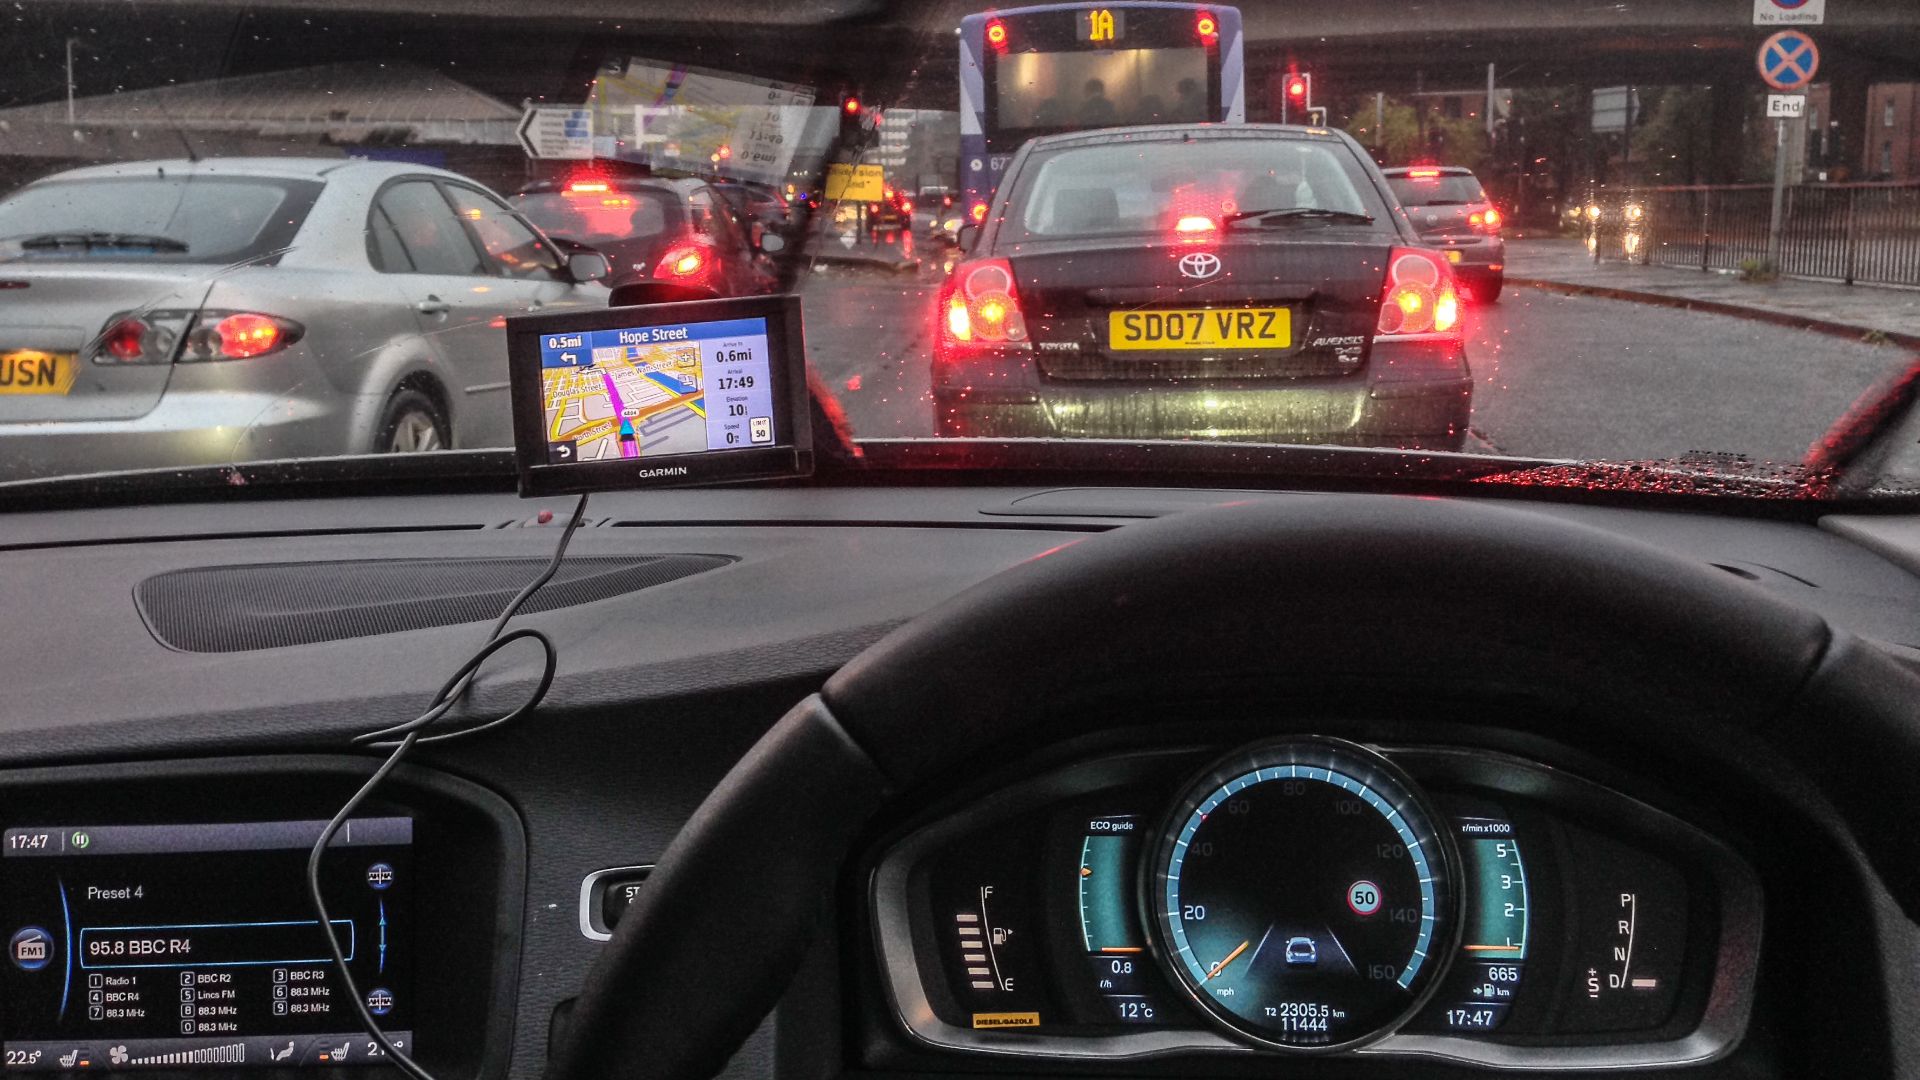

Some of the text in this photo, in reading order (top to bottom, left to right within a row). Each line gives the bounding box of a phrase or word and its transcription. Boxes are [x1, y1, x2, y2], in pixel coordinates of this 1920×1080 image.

[1760, 12, 1818, 22] No Loading
[1089, 9, 1114, 40] 1A
[1772, 100, 1800, 112] End
[990, 157, 1012, 170] 67
[1124, 311, 1277, 342] SD07 VRZ
[548, 335, 582, 349] 0.5mi
[619, 327, 688, 345] Hope Street
[1039, 342, 1080, 351] TOYOTA
[716, 348, 752, 363] 0.6mi
[0, 358, 57, 386] USN
[718, 375, 754, 390] 17:49
[552, 383, 602, 399] Douglas Street
[729, 404, 744, 416] 10
[591, 421, 612, 435] Street
[756, 429, 766, 438] 50
[639, 466, 687, 478] GARMIN
[1227, 800, 1250, 814] 60
[1335, 800, 1362, 814] 100
[1090, 821, 1134, 833] ECO guide
[1462, 823, 1510, 833] r/min x1000
[10, 834, 48, 849] 17:47
[1376, 844, 1404, 859] 120
[1496, 844, 1507, 858] 5
[1501, 875, 1511, 889] 3
[88, 885, 143, 900] Preset 4
[984, 886, 993, 899] F
[1354, 891, 1375, 905] 50
[1620, 893, 1631, 907] P
[1184, 905, 1205, 920] 20
[1389, 908, 1418, 923] 140
[1504, 903, 1515, 917] 2
[1618, 920, 1630, 934] R
[21, 946, 43, 957] FM1
[89, 939, 191, 955] 95.8 BBC R4
[1614, 947, 1626, 961] N
[1111, 960, 1132, 974] 0.8
[1368, 964, 1396, 979] 160
[1488, 967, 1518, 981] 665
[105, 976, 130, 986] Radio
[132, 976, 137, 985] 1
[184, 974, 231, 984] 2 BBC R2
[277, 970, 325, 981] 3 BBC R3
[1609, 974, 1620, 988] D
[1004, 978, 1014, 991] E
[1588, 977, 1600, 992] S
[92, 992, 140, 1003] 4 BBC R4
[184, 990, 236, 1000] 5 Lincs FM
[276, 987, 330, 998] 6 88.3 MHz
[1216, 987, 1234, 997] mph
[1497, 988, 1510, 997] km
[93, 1007, 145, 1018] 7 88.3 MHz
[184, 1005, 237, 1016] 8 88.3 MHz
[277, 1003, 330, 1013] 9 88.3 MHz
[1264, 1003, 1345, 1018] T2 2305.5 km
[1281, 1018, 1328, 1031] 11444
[1447, 1010, 1493, 1026] 17:47
[184, 1022, 237, 1032] 0 88.3 MHz
